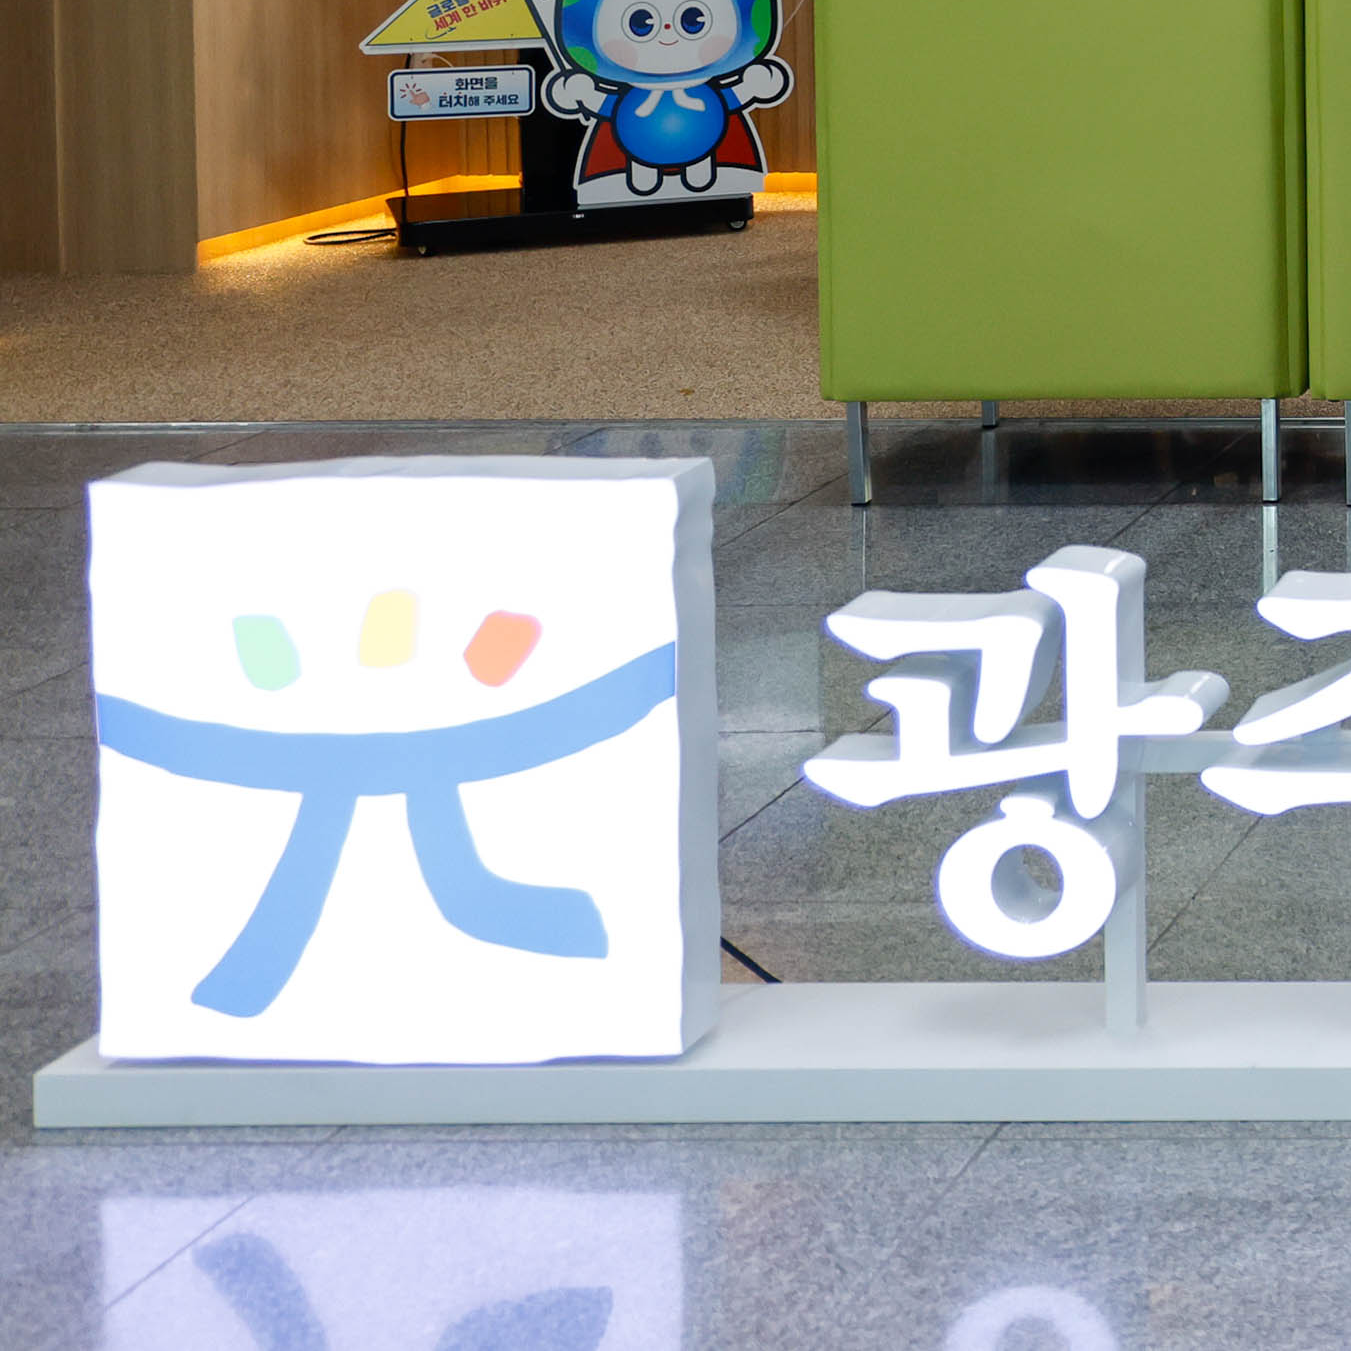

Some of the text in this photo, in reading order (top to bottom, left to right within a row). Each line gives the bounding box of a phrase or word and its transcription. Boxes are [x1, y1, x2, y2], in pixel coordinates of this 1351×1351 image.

[433, 9, 463, 31] 세계
[461, 3, 479, 19] 한
[455, 76, 498, 91] 화면을
[438, 93, 520, 108] 터치해 주세요
